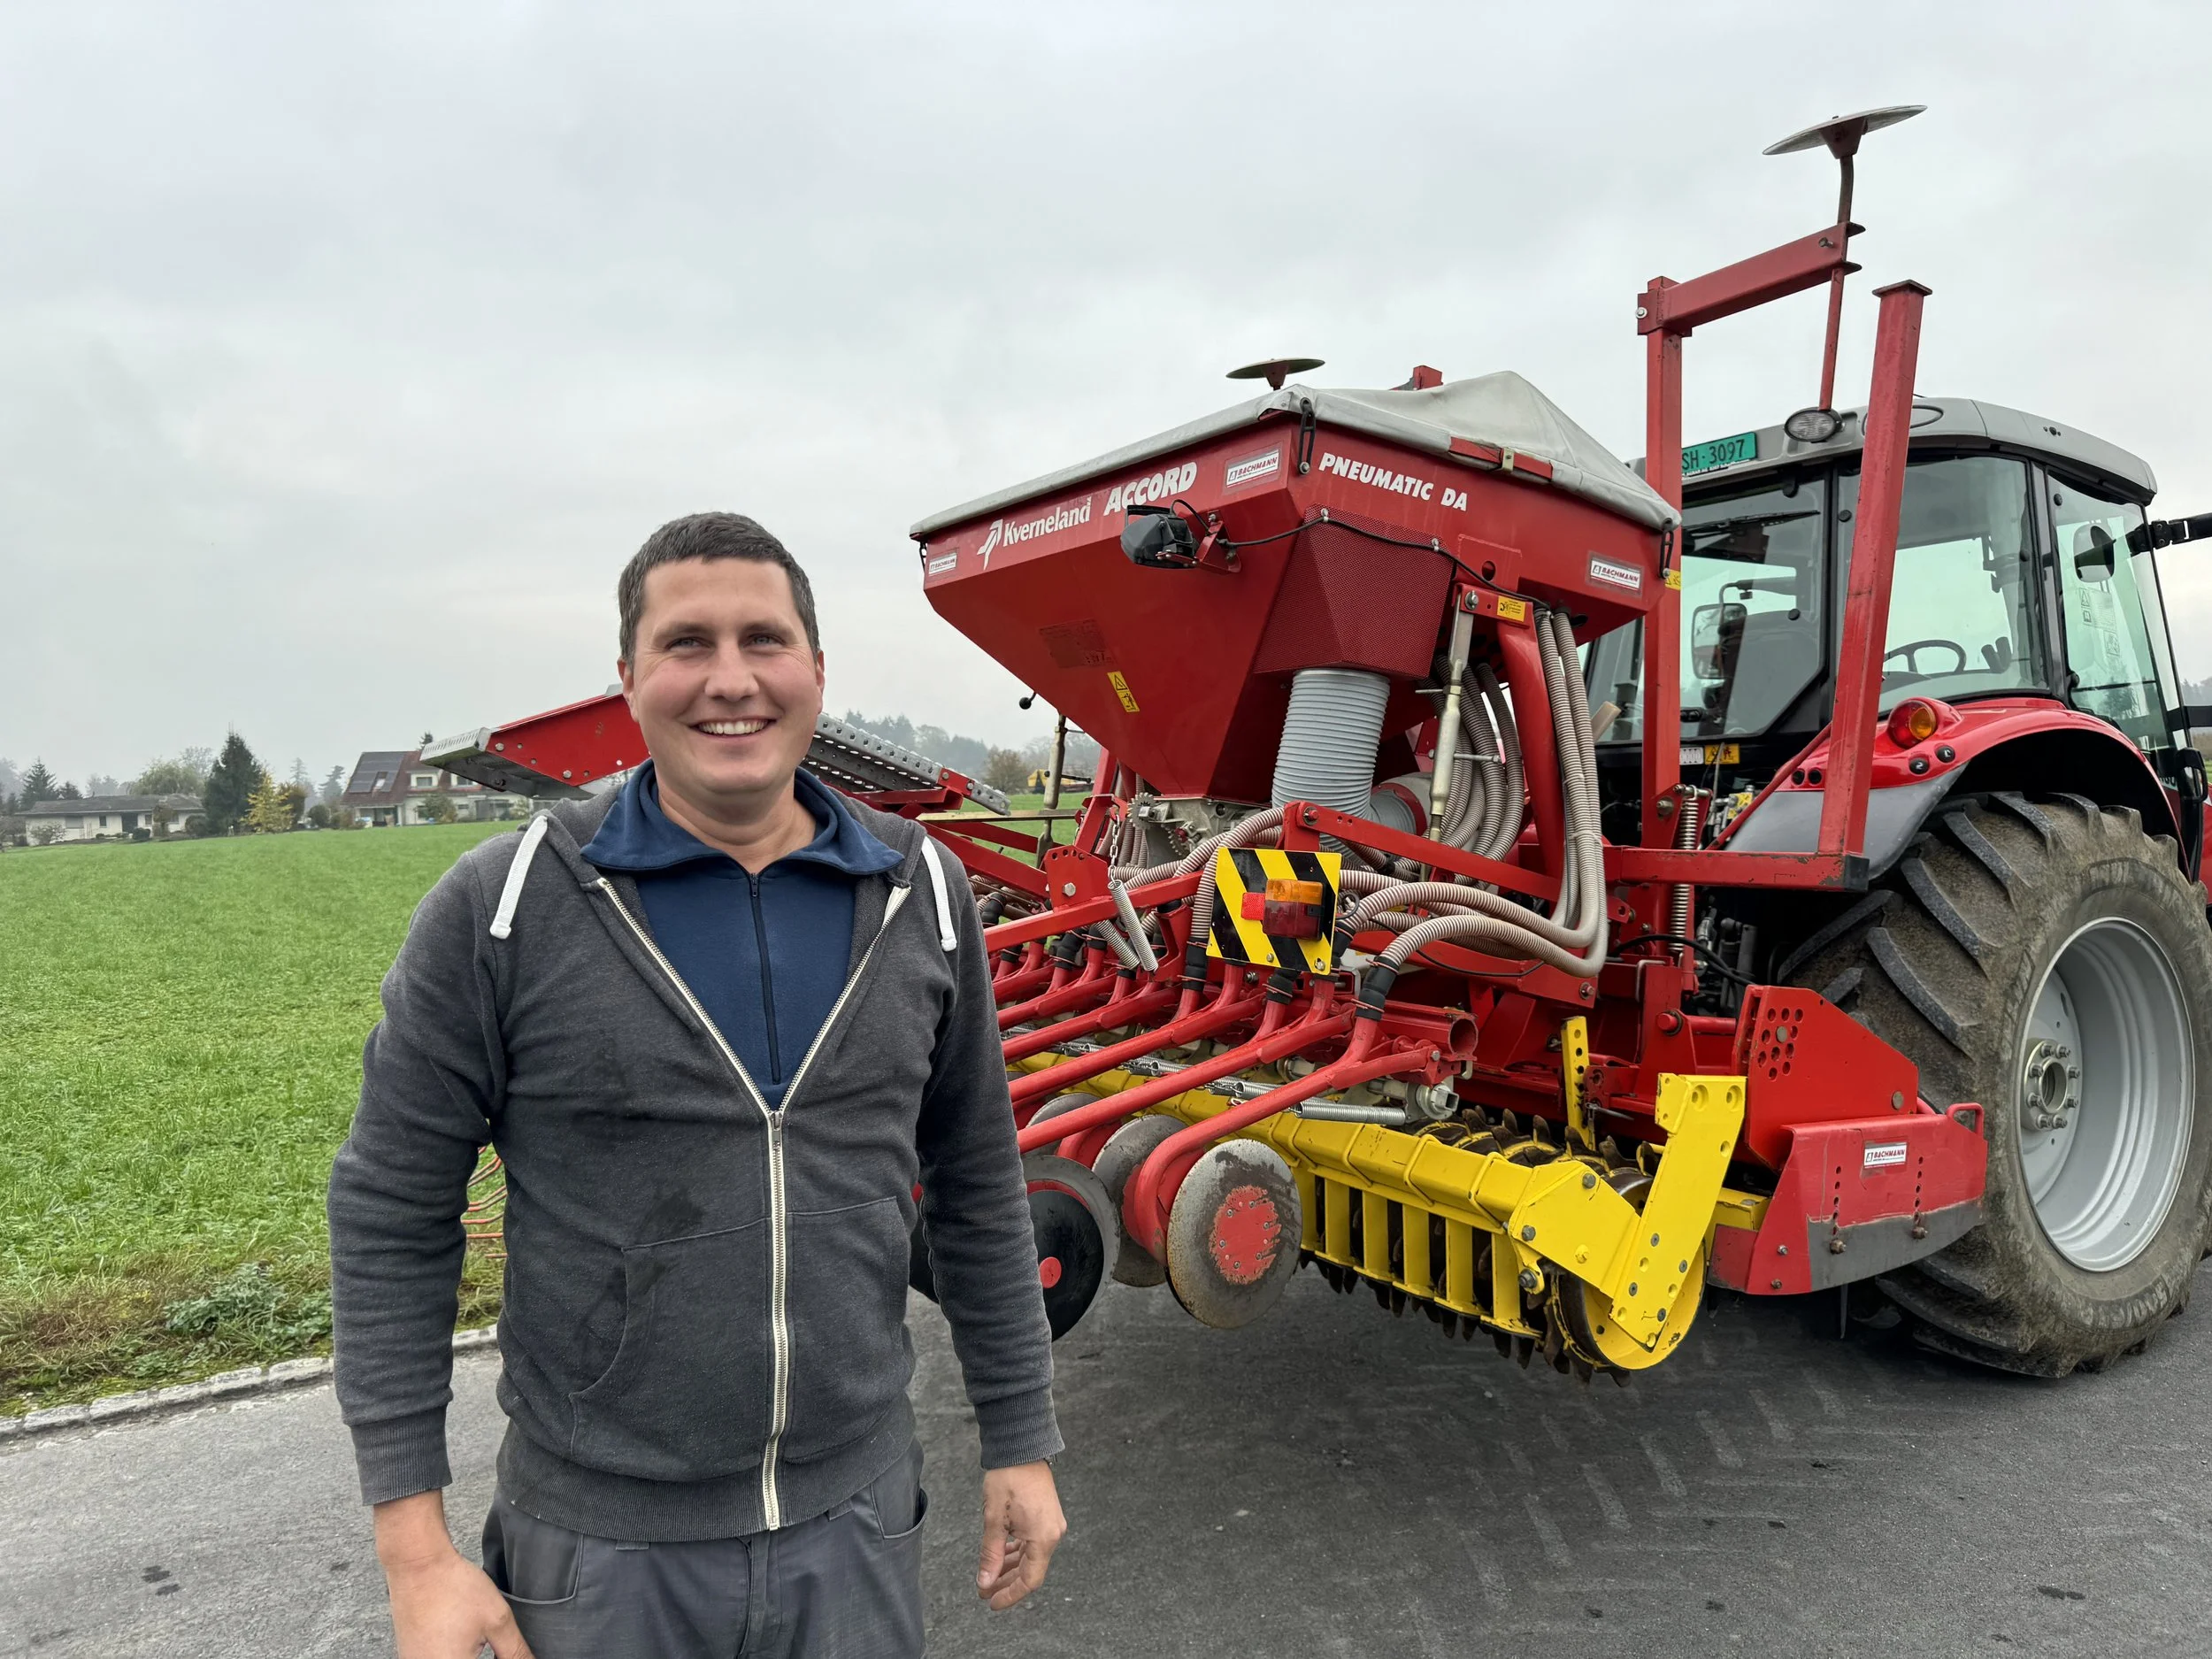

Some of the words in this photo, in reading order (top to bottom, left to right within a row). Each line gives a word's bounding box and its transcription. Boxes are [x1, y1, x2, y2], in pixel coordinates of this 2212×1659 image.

[1238, 457, 1277, 475] BACHMANN
[1318, 452, 1434, 501] PNEUMATIC
[1440, 488, 1468, 511] DA
[1002, 496, 1092, 547] Kverneland
[1103, 462, 1197, 516] ACCORD
[1602, 567, 1638, 581] BACHMANN
[1873, 1149, 1904, 1158] BACHMANN
